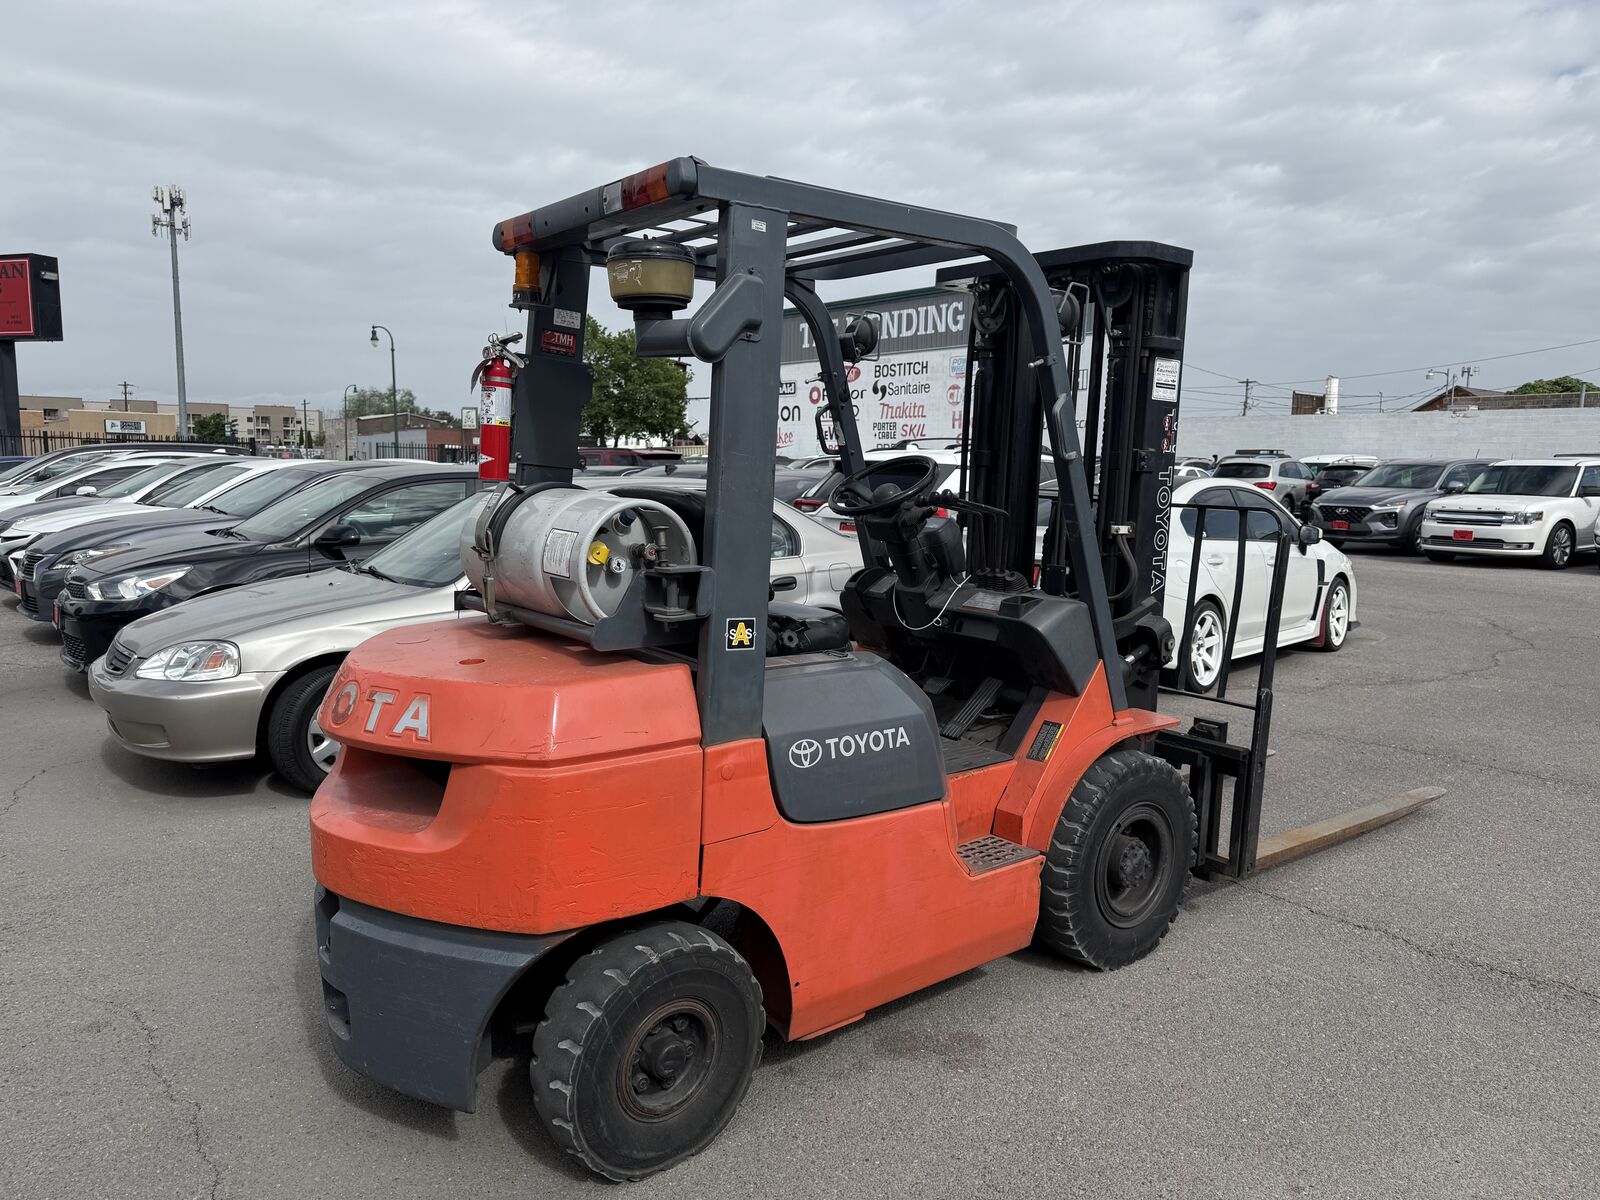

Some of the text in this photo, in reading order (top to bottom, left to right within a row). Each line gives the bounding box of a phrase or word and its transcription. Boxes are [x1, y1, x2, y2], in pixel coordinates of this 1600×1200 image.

[0, 264, 24, 279] AN
[846, 301, 966, 340] NDING
[874, 361, 928, 378] BOSTITCH
[779, 383, 795, 395] Aid
[887, 382, 931, 396] Sanitaire
[879, 402, 927, 420] Makita
[872, 422, 897, 431] PORTER
[901, 424, 926, 437] SKIL
[1151, 466, 1173, 594] TOYOTA
[729, 622, 752, 645] SAS
[331, 682, 430, 741] OTA
[825, 726, 910, 759] TOYOTA
